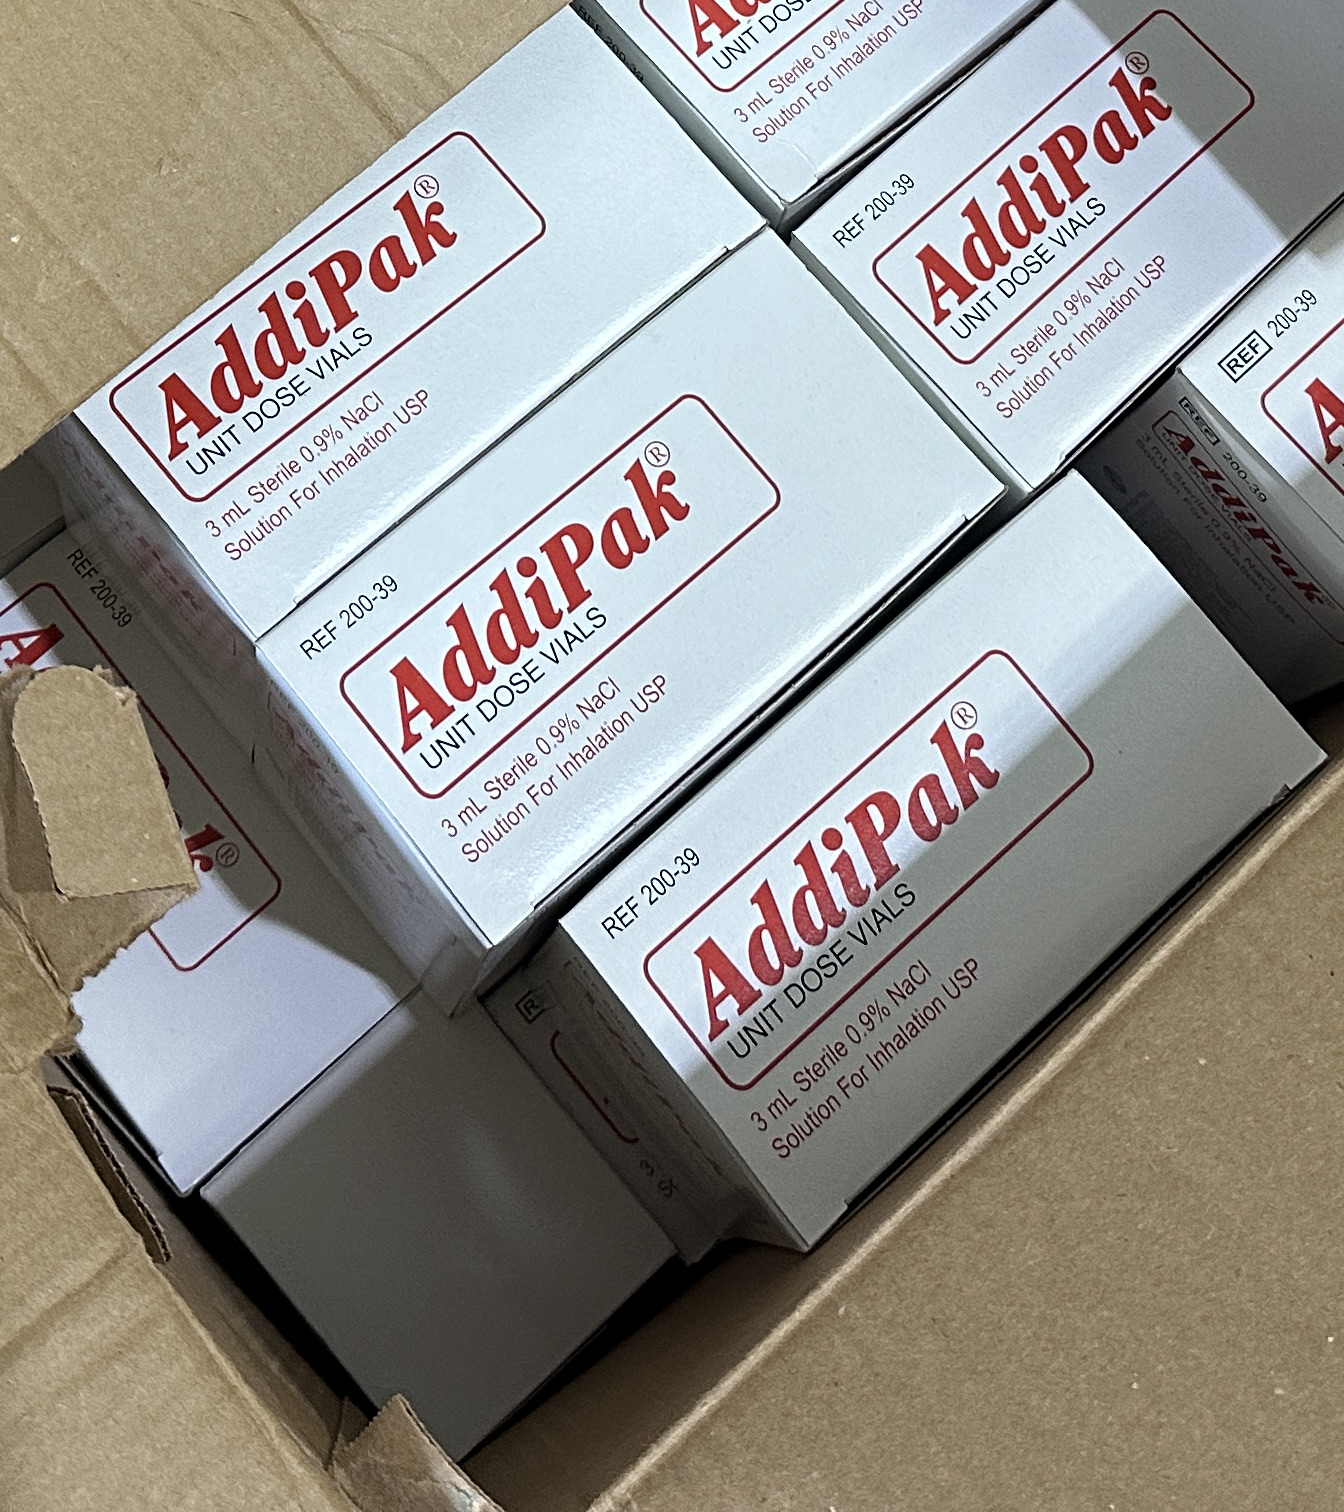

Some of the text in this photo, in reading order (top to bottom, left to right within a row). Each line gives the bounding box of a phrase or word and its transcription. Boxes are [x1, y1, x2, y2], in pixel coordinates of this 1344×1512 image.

[712, 26, 759, 69] UNIT
[734, 108, 748, 122] 3
[748, 92, 773, 114] mL
[769, 58, 814, 93] Sterile
[812, 28, 849, 59] 0.9%
[753, 97, 810, 142] Solution
[806, 75, 833, 99] For
[830, 25, 897, 79] Inhalation
[833, 174, 914, 248] REF 200-39
[1226, 290, 1316, 374] REF 200-39
[67, 548, 132, 627] REF 200-39
[300, 576, 397, 659] REF 200-39
[420, 607, 606, 768] UNIT DOSE VIALS
[442, 676, 620, 837] 3 mL Sterile 0.9% NaCl
[462, 675, 665, 862] Solution For Inhalation USP
[601, 848, 699, 939] REF 200-39
[727, 884, 915, 1058] UNIT DOSE VIALS
[751, 960, 931, 1131] 3 mL Sterile 0.9% NaCl
[772, 959, 977, 1158] Solution For Inhalation USP
